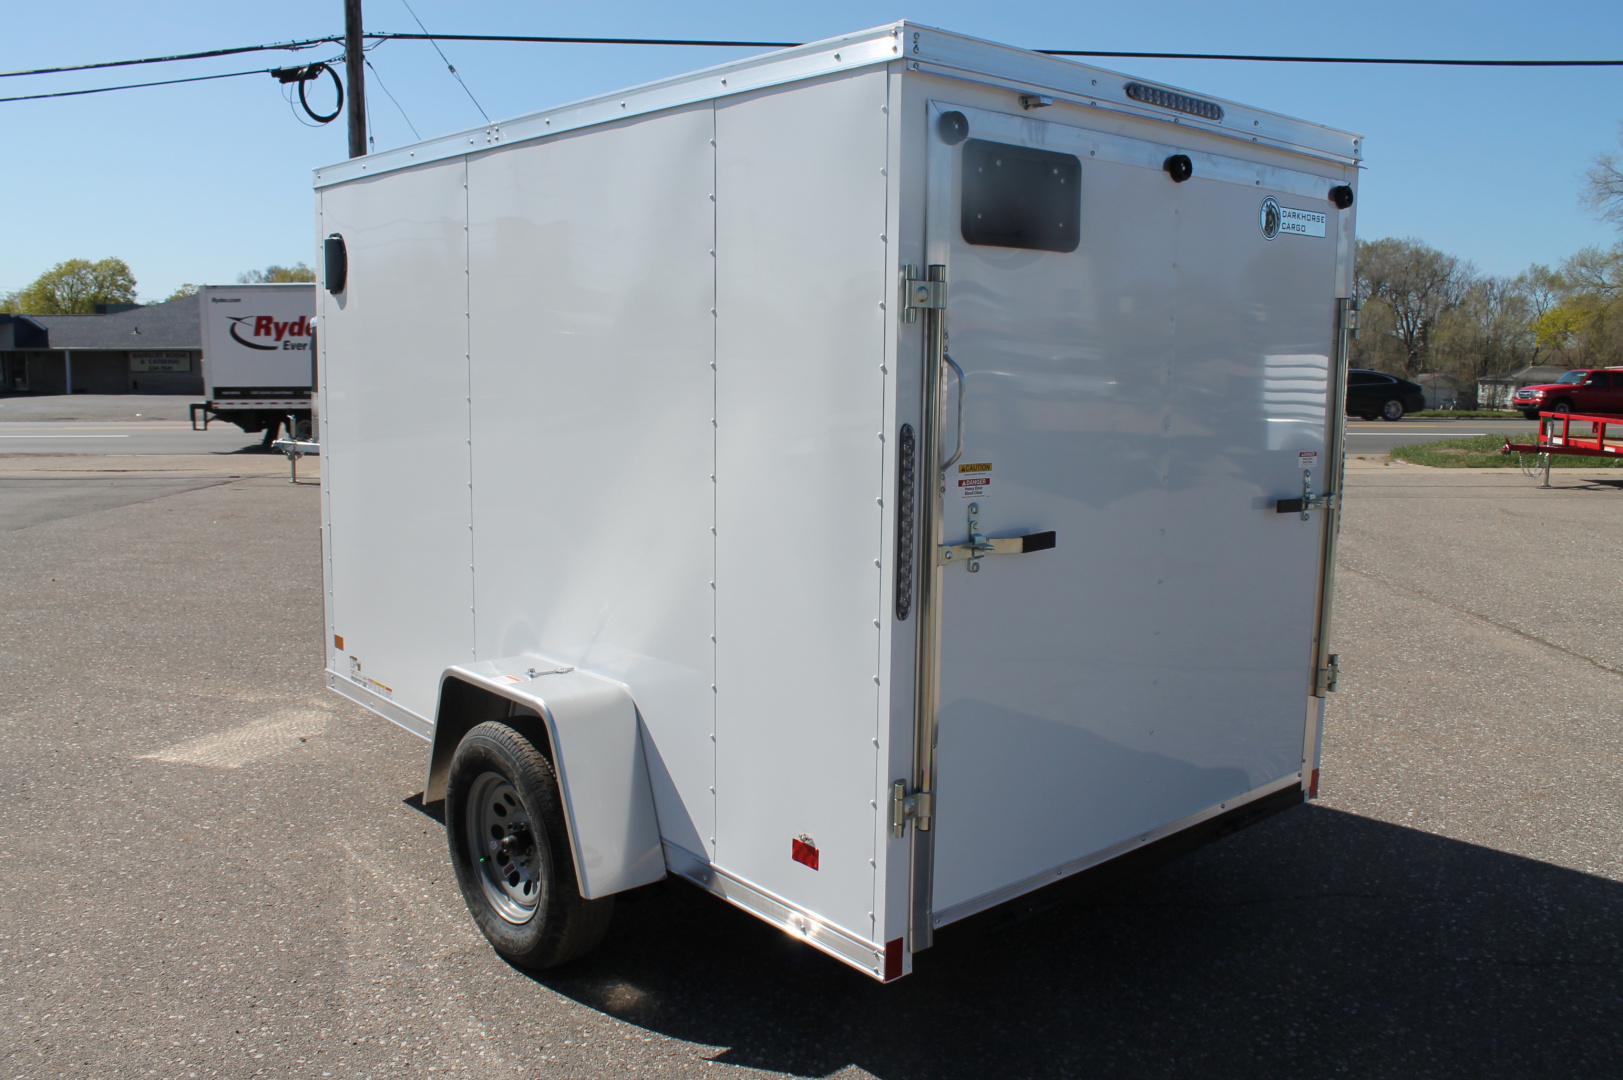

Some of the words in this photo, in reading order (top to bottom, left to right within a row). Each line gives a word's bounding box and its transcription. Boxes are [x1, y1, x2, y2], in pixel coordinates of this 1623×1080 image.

[1282, 210, 1325, 223] DARKHORSE
[1281, 222, 1306, 232] CARGO
[283, 340, 308, 351] Ever
[966, 463, 990, 471] CAUTION
